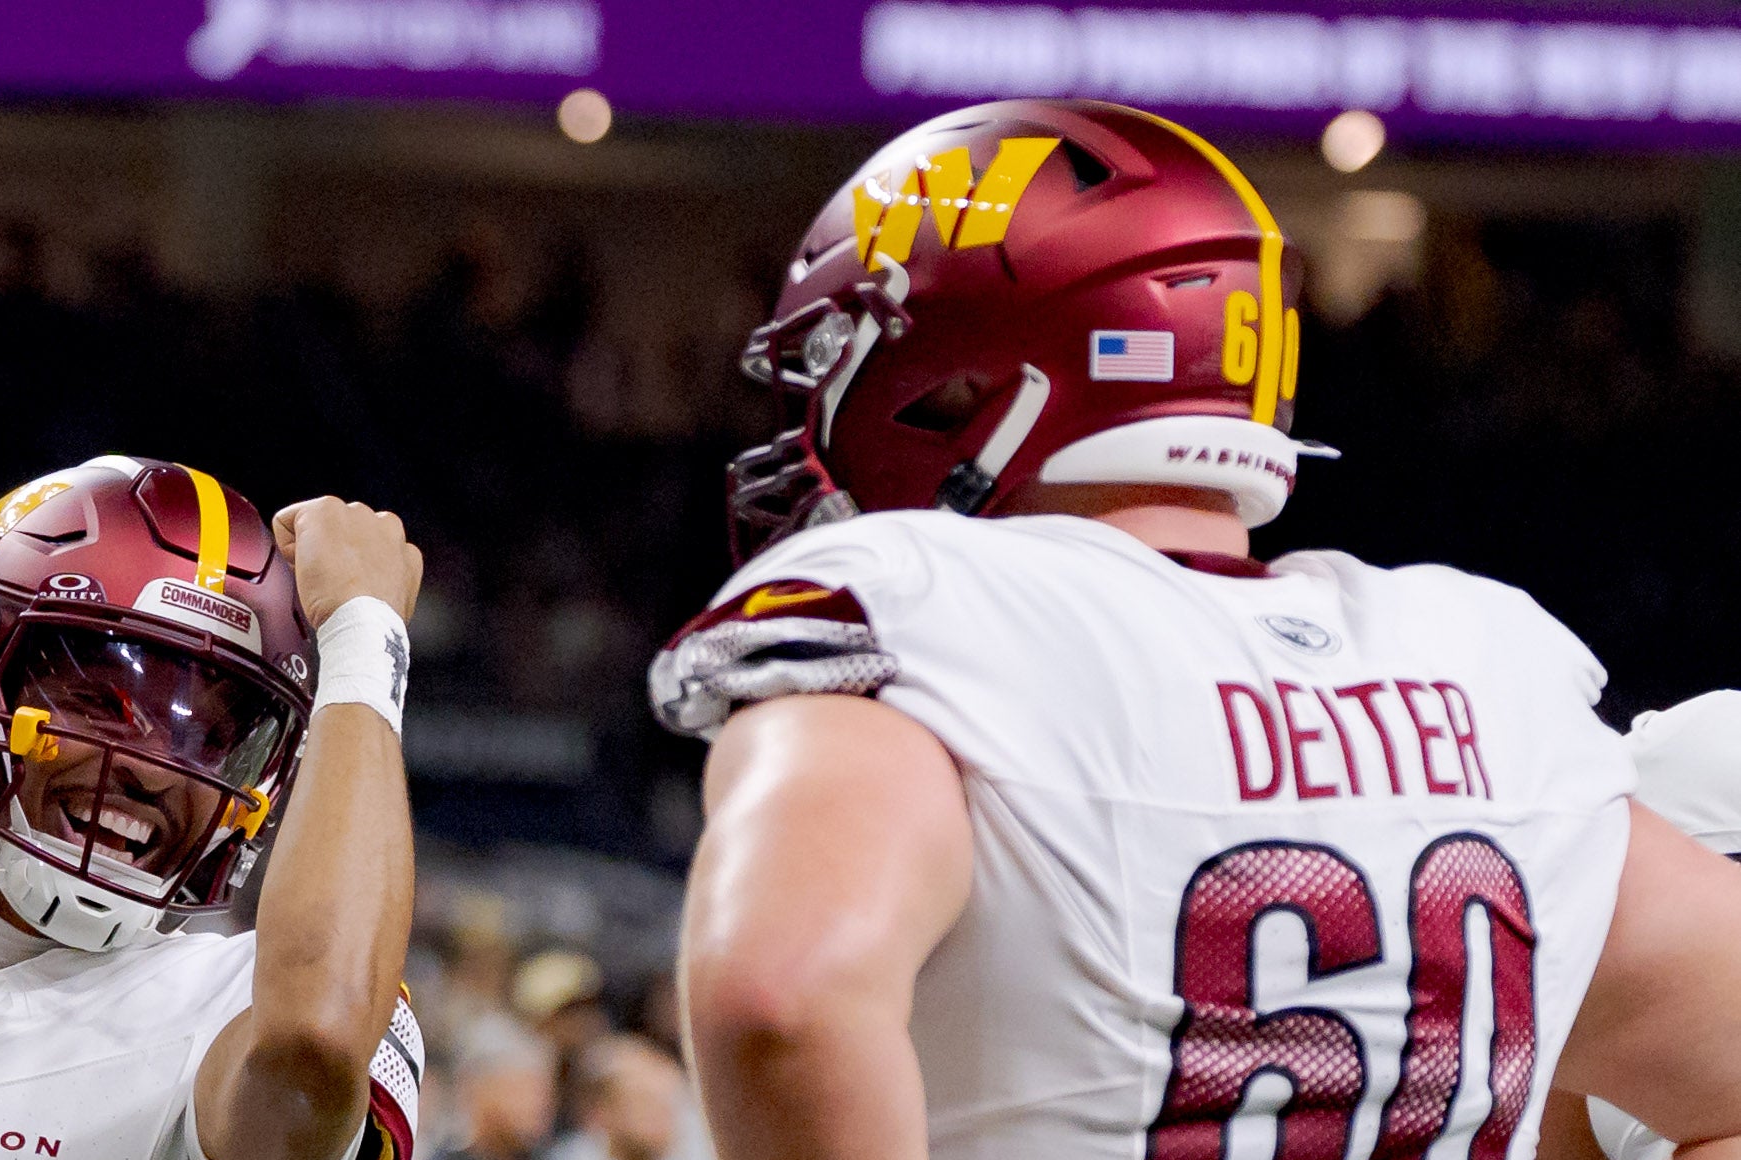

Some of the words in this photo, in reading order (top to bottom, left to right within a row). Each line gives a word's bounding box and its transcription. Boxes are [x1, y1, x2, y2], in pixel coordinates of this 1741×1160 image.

[1222, 290, 1300, 400] 60
[161, 585, 251, 632] COMMANDERS
[1216, 677, 1494, 801] DEITER
